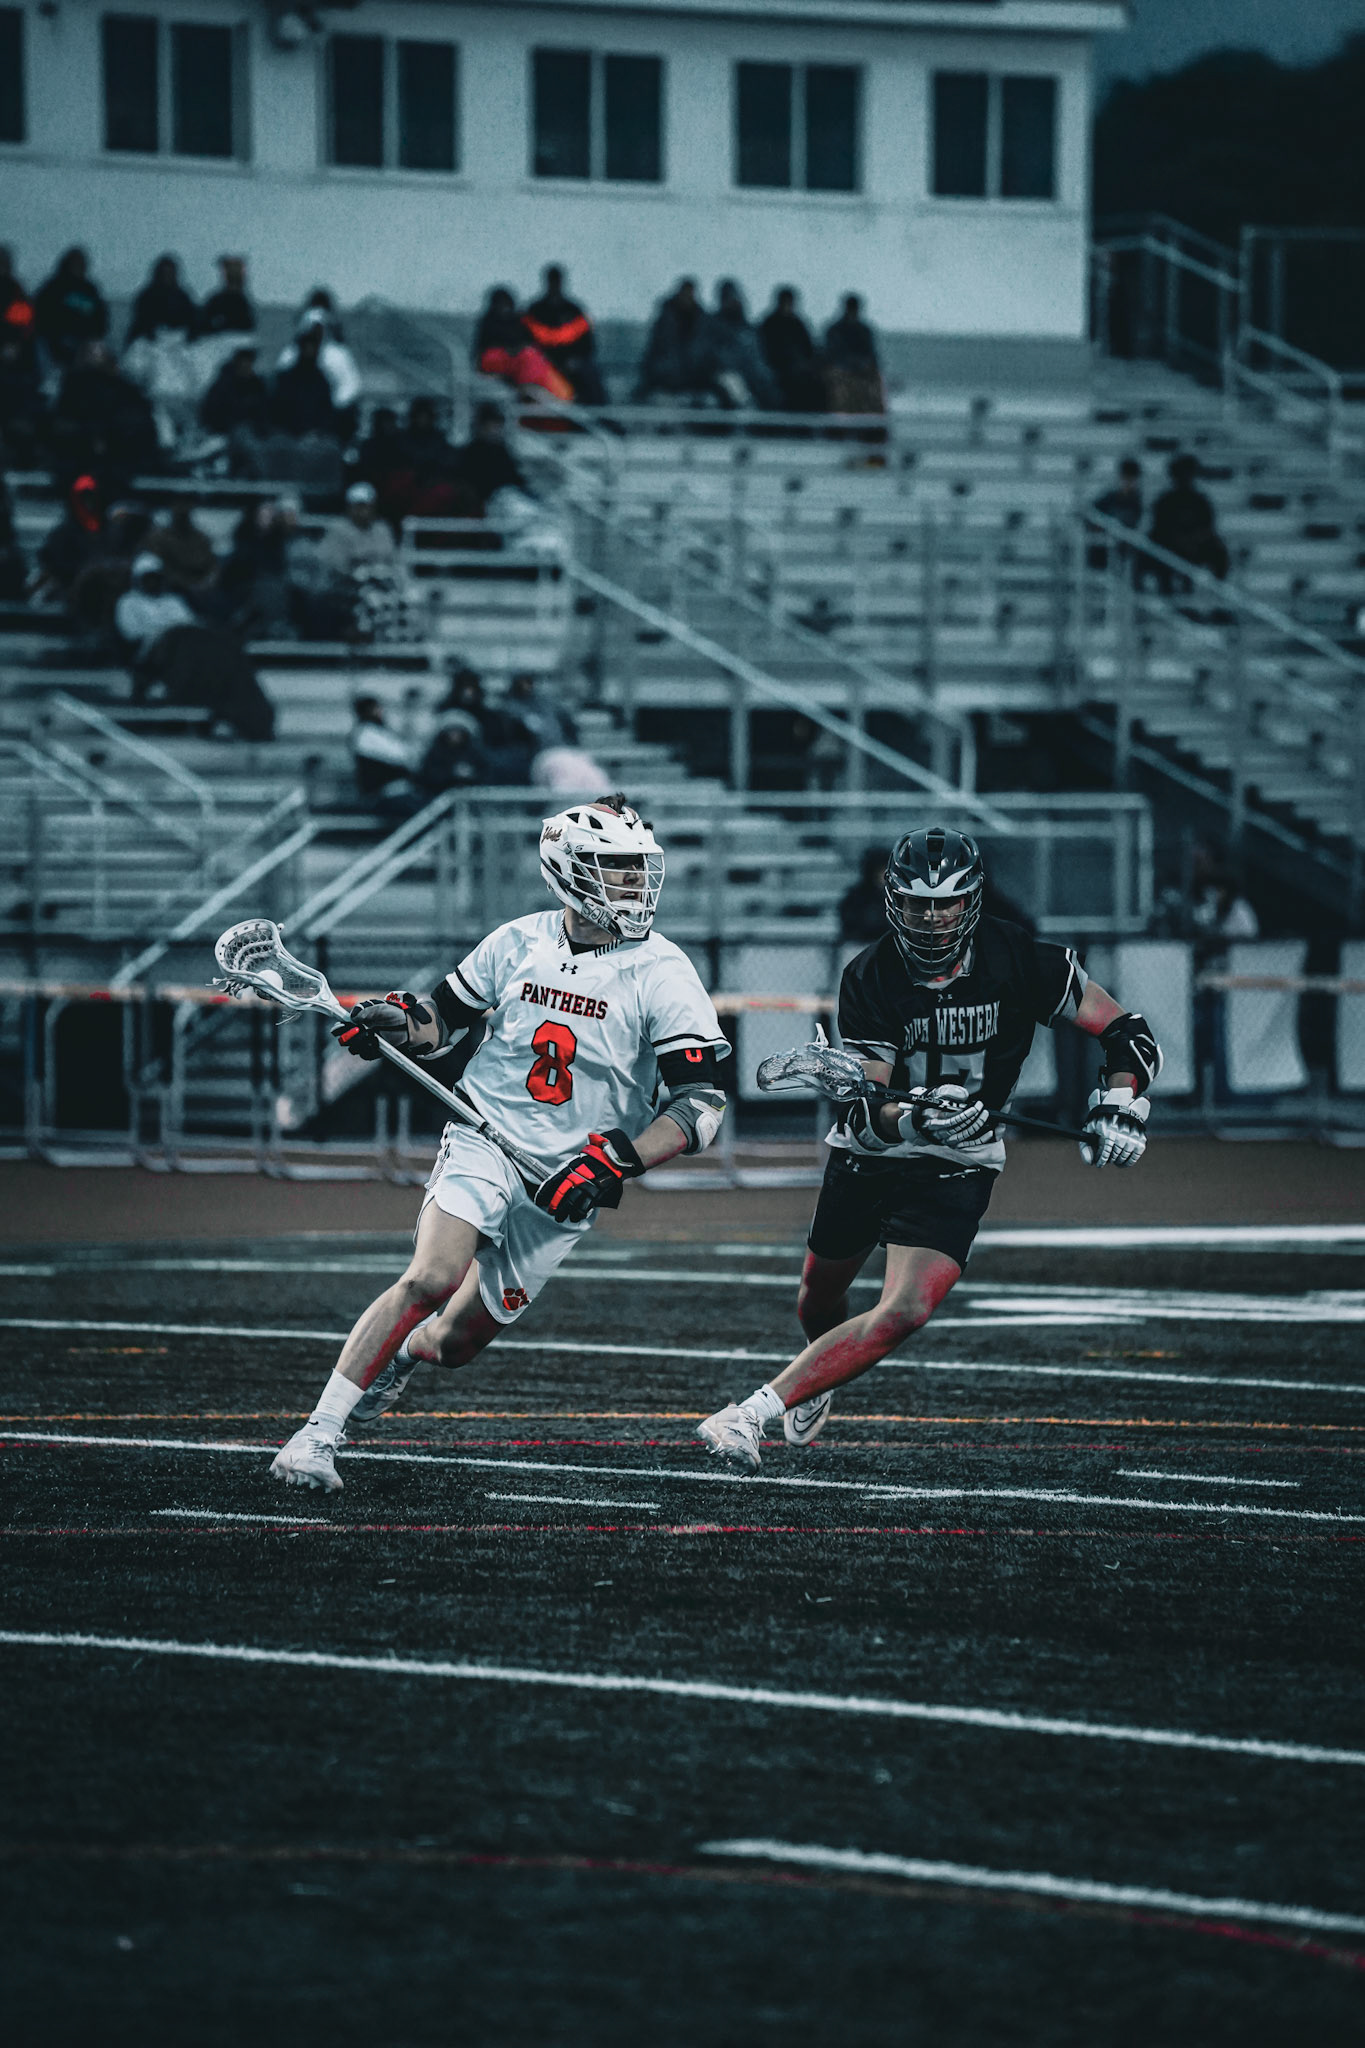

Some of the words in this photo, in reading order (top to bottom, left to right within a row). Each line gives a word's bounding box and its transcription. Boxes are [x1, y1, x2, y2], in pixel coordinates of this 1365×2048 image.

[520, 982, 609, 1021] PANTHERS
[935, 1000, 1001, 1046] WESTERN
[525, 1020, 578, 1106] 8
[903, 1049, 987, 1096] 17
